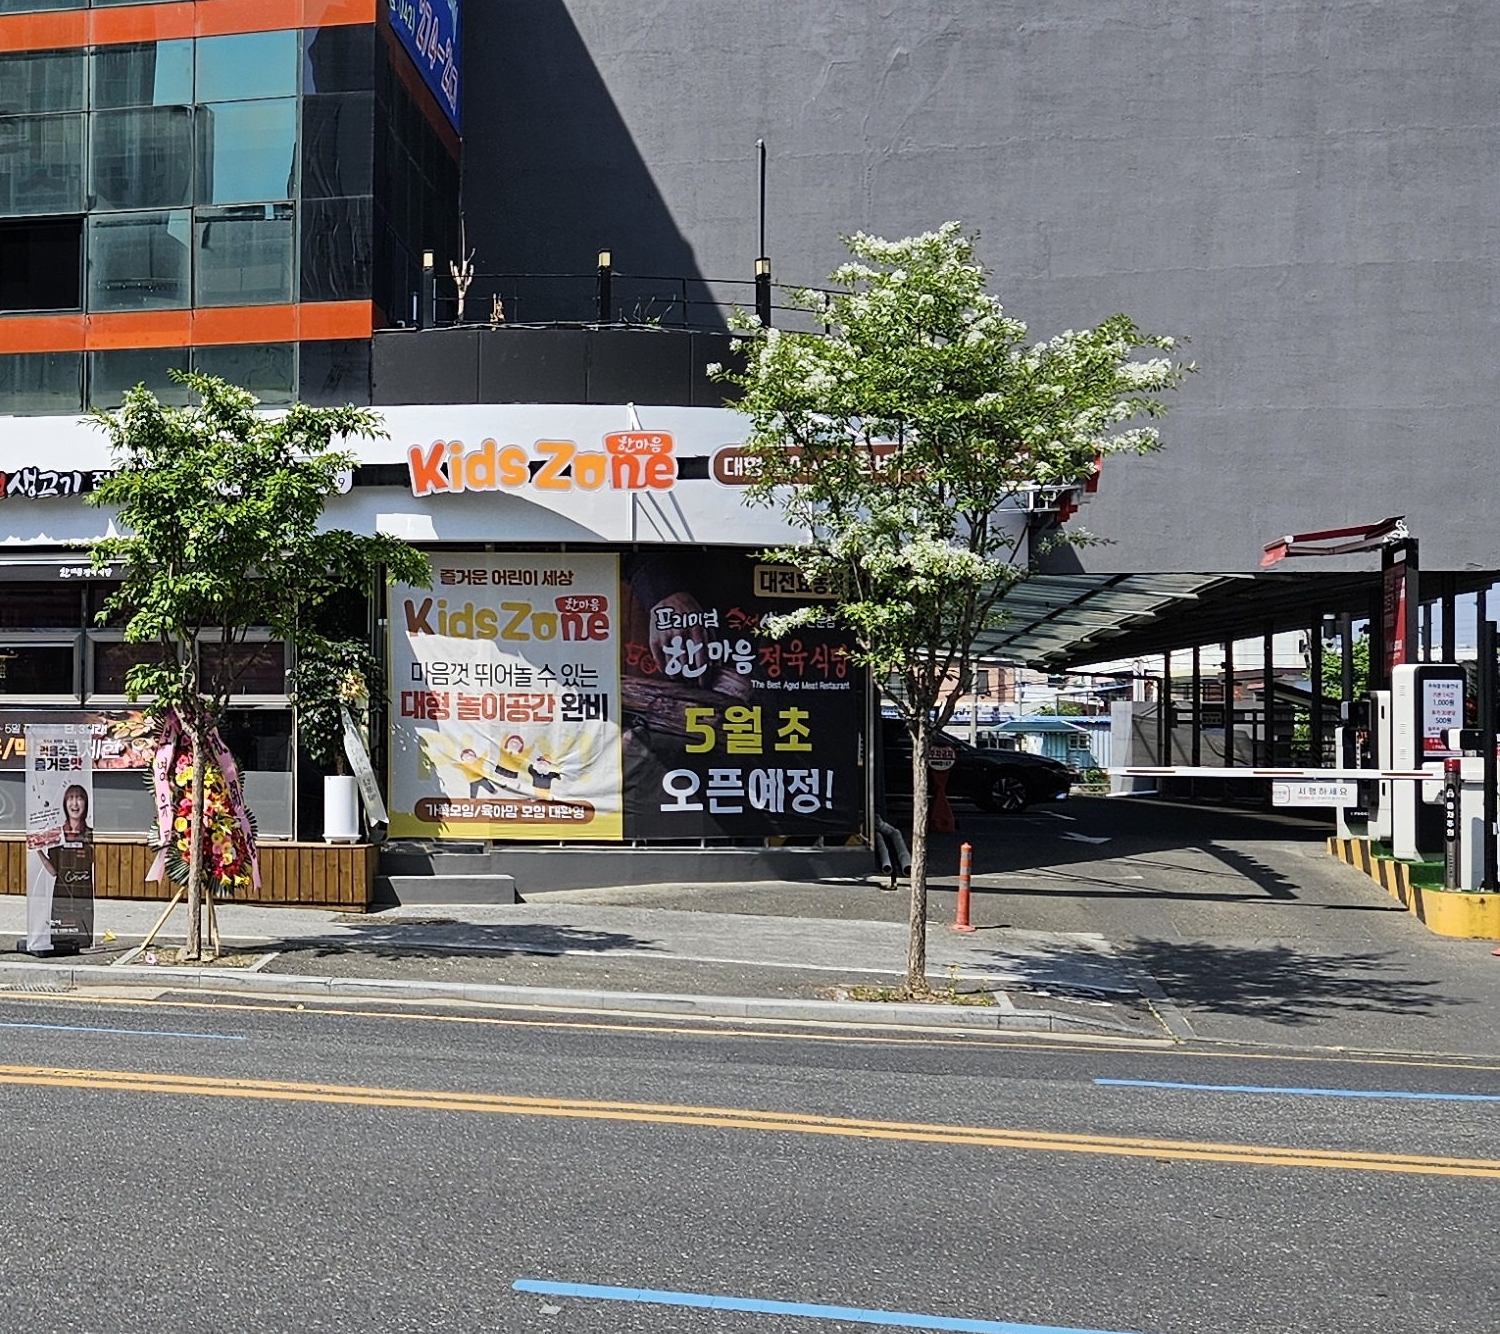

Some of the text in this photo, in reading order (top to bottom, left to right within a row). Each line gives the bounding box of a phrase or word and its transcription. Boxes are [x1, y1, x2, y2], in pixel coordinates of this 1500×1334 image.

[616, 435, 664, 453] 한마음
[440, 569, 574, 586] 즐거운 어린이 세상
[564, 597, 600, 612] 한마음
[654, 607, 720, 629] 프리미엄
[411, 662, 599, 688] 마음껏 뛰어놀 수 있는
[751, 679, 851, 691] The Best Aged Meat Restaurant
[401, 690, 609, 722] 대형 놀이공간 완비
[4, 722, 21, 735] 5일
[684, 705, 813, 754] 5월 초
[660, 768, 834, 814] 오픈예정!
[521, 804, 546, 819] 모임
[548, 805, 585, 820] 대환영
